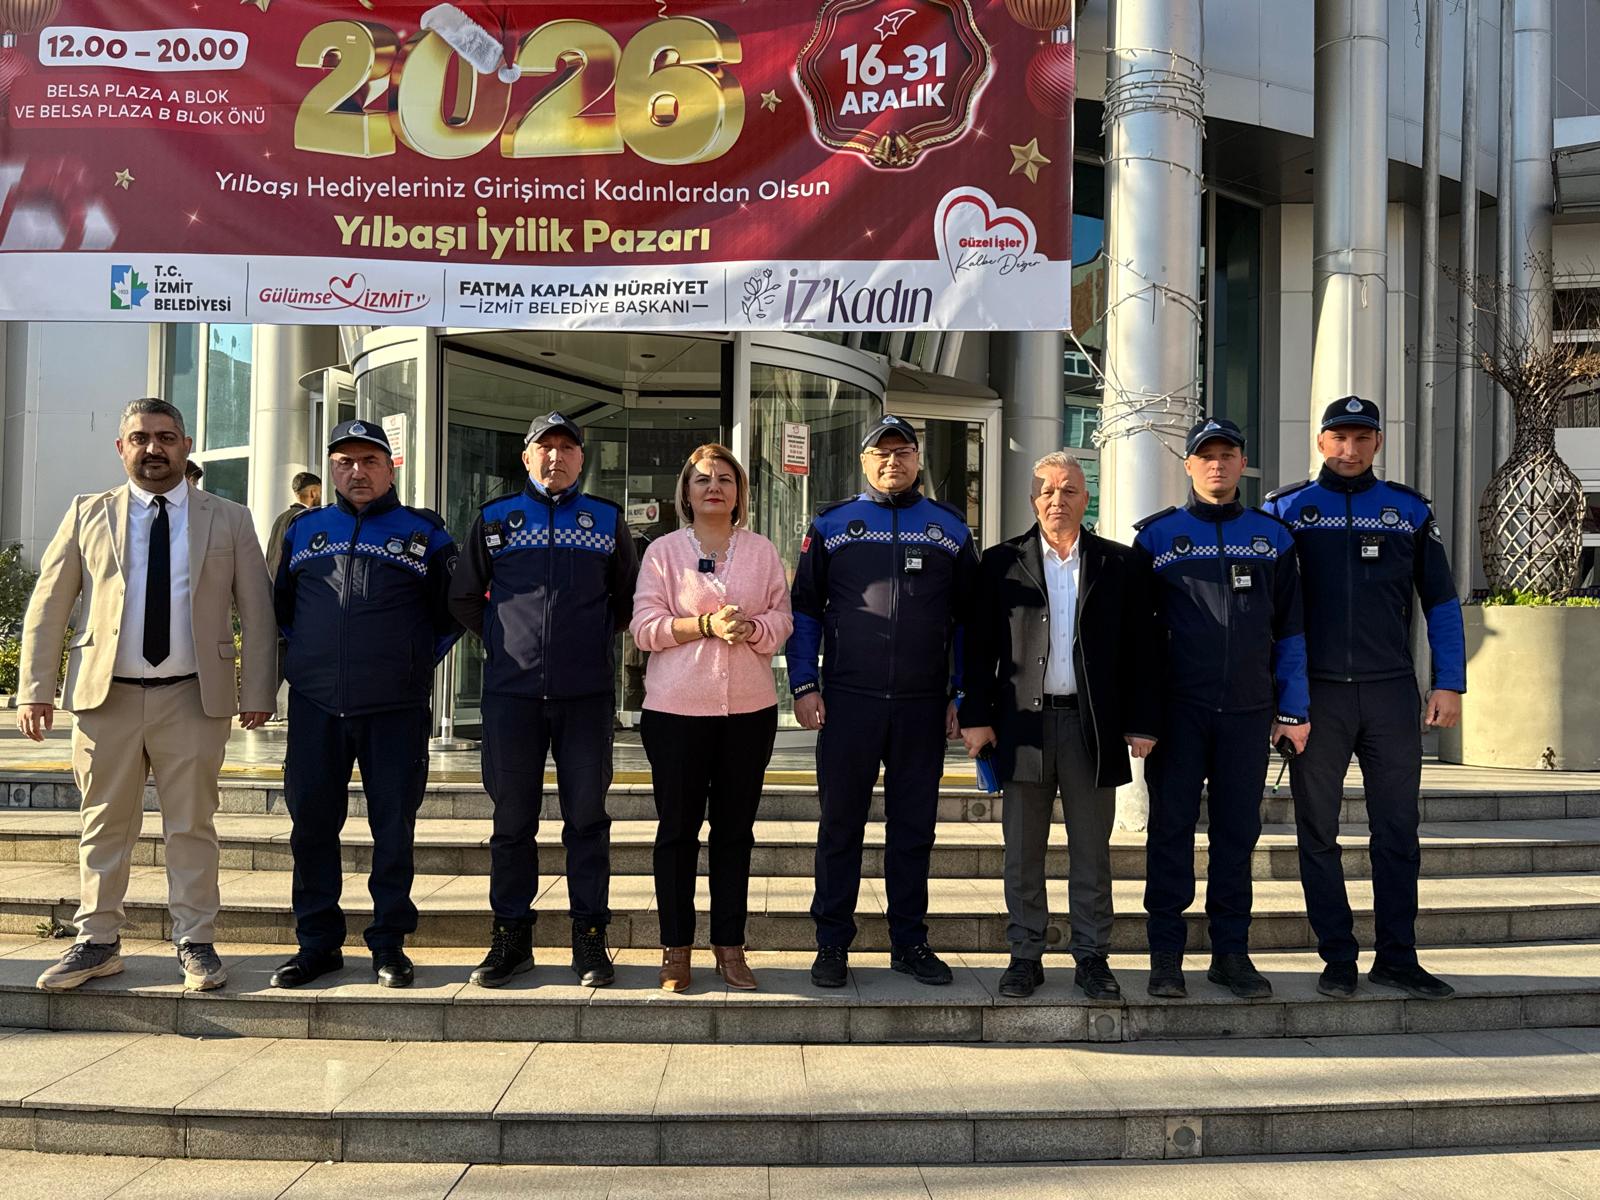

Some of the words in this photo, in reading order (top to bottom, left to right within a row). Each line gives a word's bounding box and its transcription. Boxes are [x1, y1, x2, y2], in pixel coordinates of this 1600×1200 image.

[47, 34, 128, 59] 12.00
[157, 37, 239, 63] 20.00
[840, 41, 947, 85] 16-31
[47, 84, 100, 99] BELSA
[104, 84, 163, 101] PLAZA
[169, 90, 180, 104] A
[185, 89, 229, 104] BLOK
[294, 15, 746, 165] 2026
[839, 82, 945, 116] ARALIK
[14, 105, 35, 119] VE
[39, 104, 92, 118] BELSA
[97, 105, 153, 119] PLAZA
[158, 107, 171, 120] B
[176, 109, 224, 125] BLOK
[228, 106, 266, 125] ÖNÜ
[215, 171, 298, 199] Yılbaşı
[307, 176, 466, 202] Hediyeleriniz
[474, 177, 585, 203] Girişimci
[595, 178, 750, 203] Kadınlardan
[758, 179, 830, 200] Olsun
[334, 215, 467, 256] Yılbaşı
[477, 206, 575, 260] İyilik
[583, 220, 711, 253] Pazarı
[959, 236, 993, 248] Güzel
[994, 235, 1022, 251] İşler
[154, 265, 182, 278] T.C.
[955, 251, 996, 274] Kalbe
[154, 279, 193, 294] İZMİT
[459, 280, 525, 297] FATMA
[530, 281, 608, 297] KAPLAN
[613, 278, 709, 296] HÜRRİYET
[154, 296, 231, 312] BELEDİYESİ
[259, 287, 333, 305] Gülümse
[363, 288, 414, 309] İZMİT
[528, 298, 610, 314] BELEDİYE
